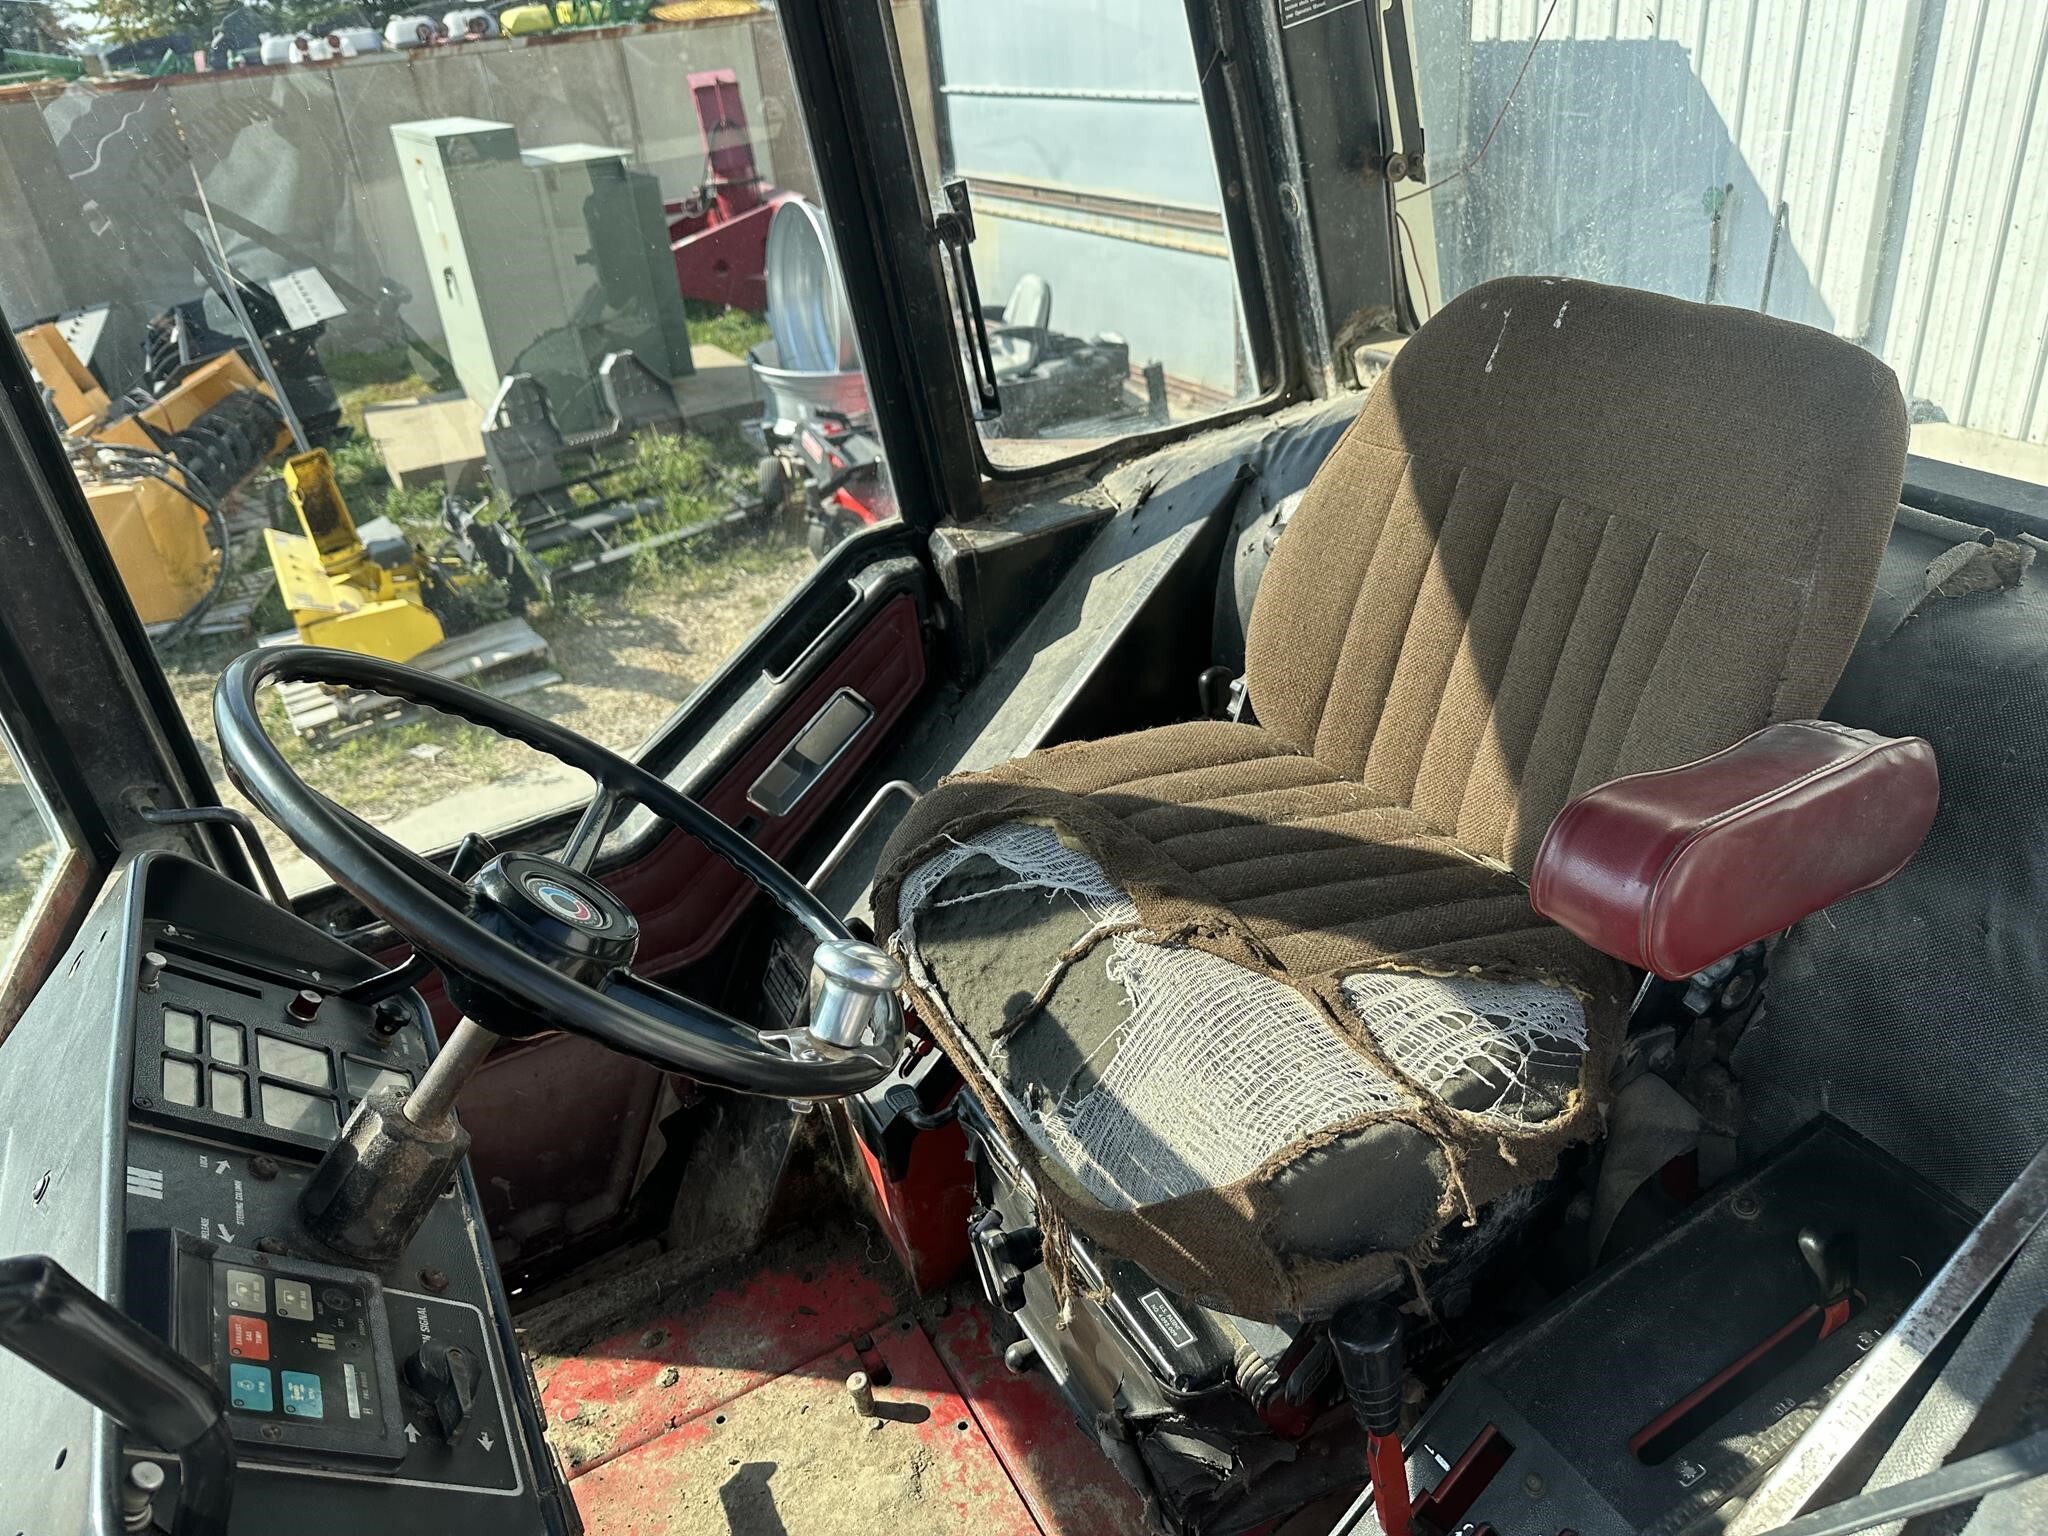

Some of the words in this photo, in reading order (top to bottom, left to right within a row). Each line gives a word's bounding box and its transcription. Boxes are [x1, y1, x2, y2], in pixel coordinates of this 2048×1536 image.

[200, 1155, 208, 1168] LOCK
[234, 1179, 244, 1201] COLUMN
[235, 1201, 245, 1226] STEERING
[201, 1217, 210, 1240] RELEASE
[416, 1306, 430, 1333] SIGNAL
[1166, 1315, 1181, 1330] PATENT
[234, 1323, 243, 1345] EXHAUST
[245, 1331, 253, 1341] GAS
